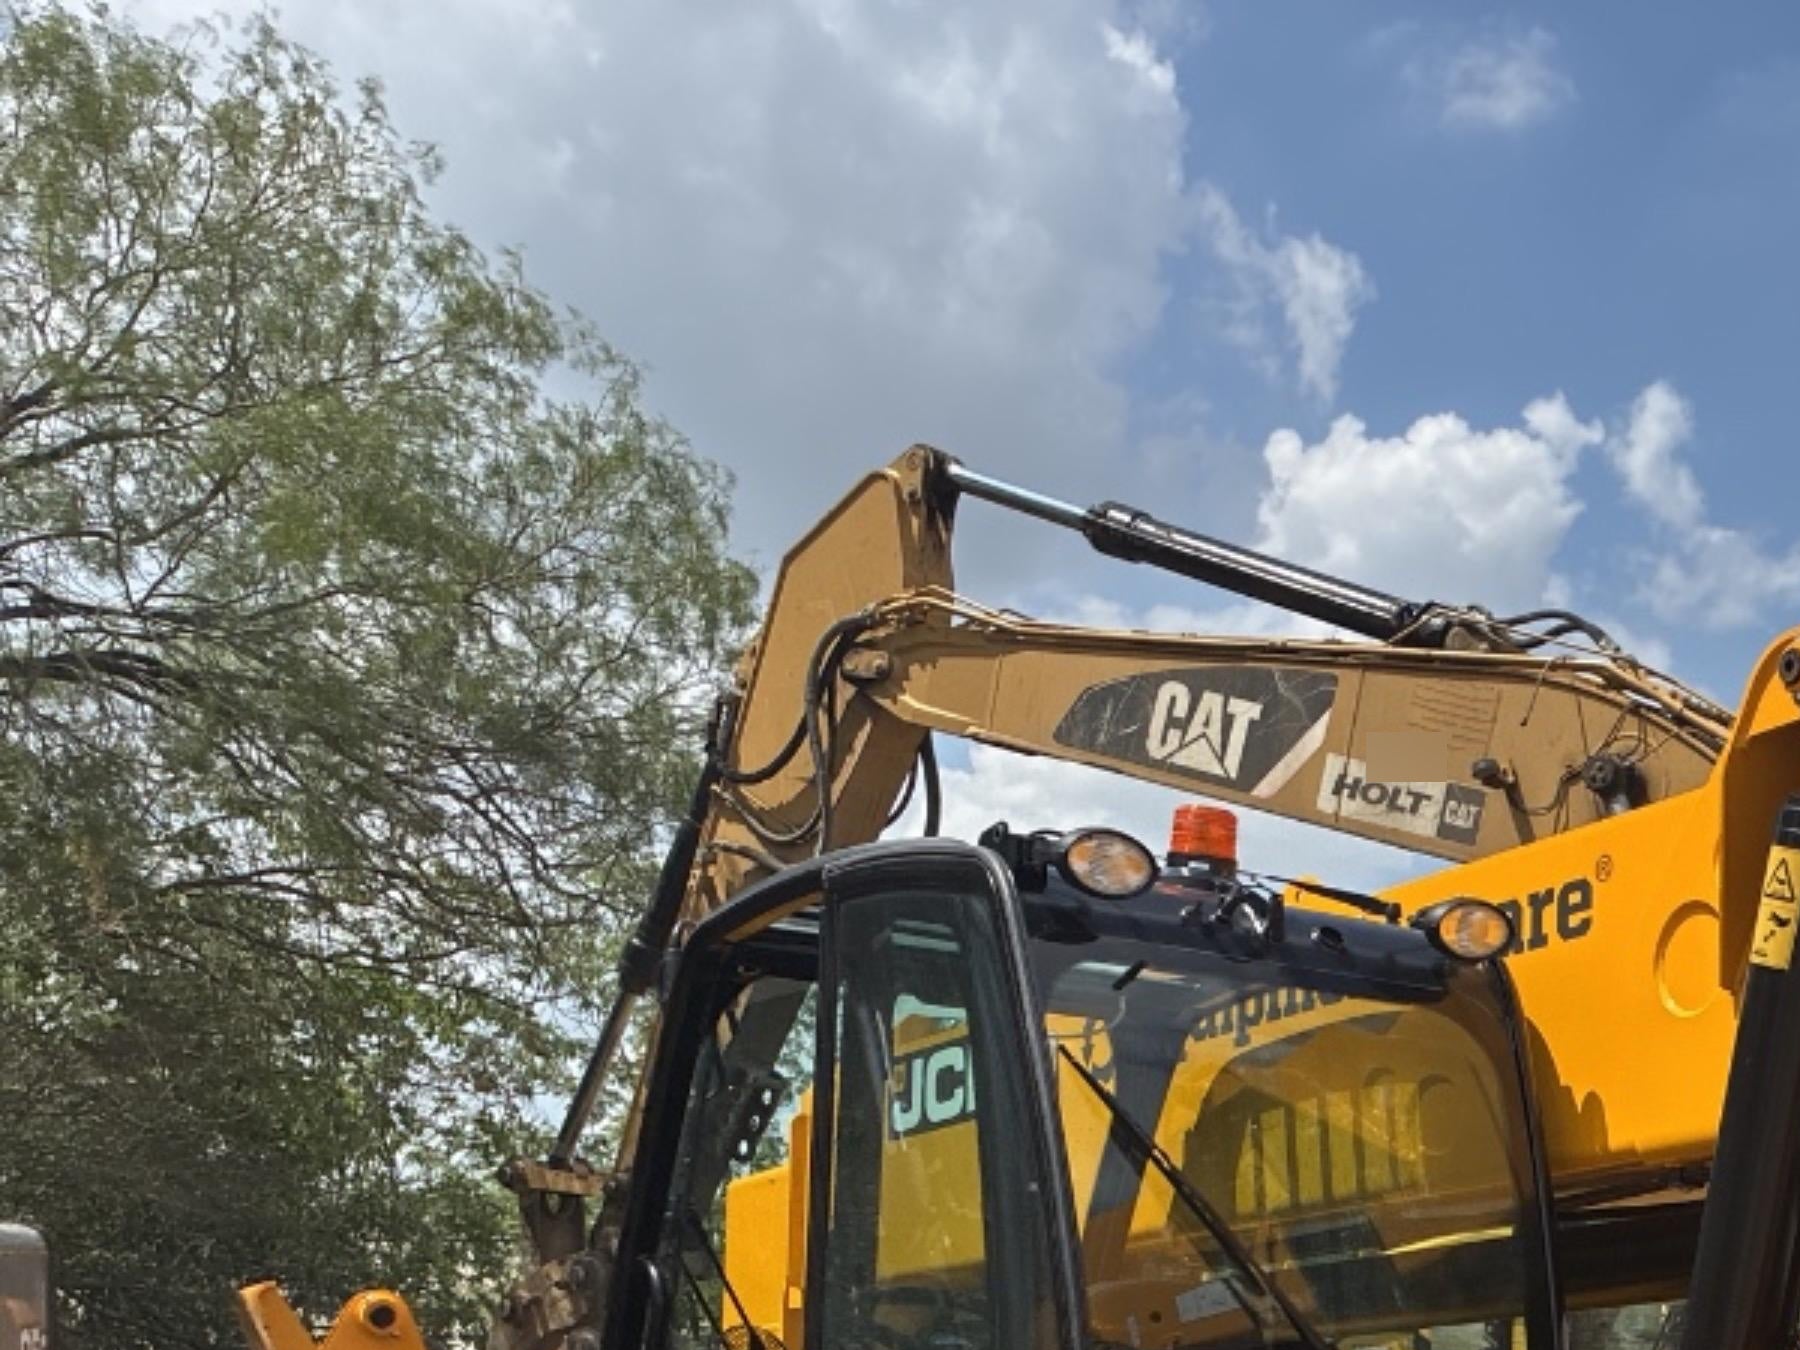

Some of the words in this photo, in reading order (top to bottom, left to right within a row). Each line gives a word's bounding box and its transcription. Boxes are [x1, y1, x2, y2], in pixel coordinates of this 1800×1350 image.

[1146, 680, 1264, 781] CAT
[1332, 772, 1435, 817] HOLT
[1446, 800, 1480, 829] CAT
[890, 1045, 977, 1133] JC
